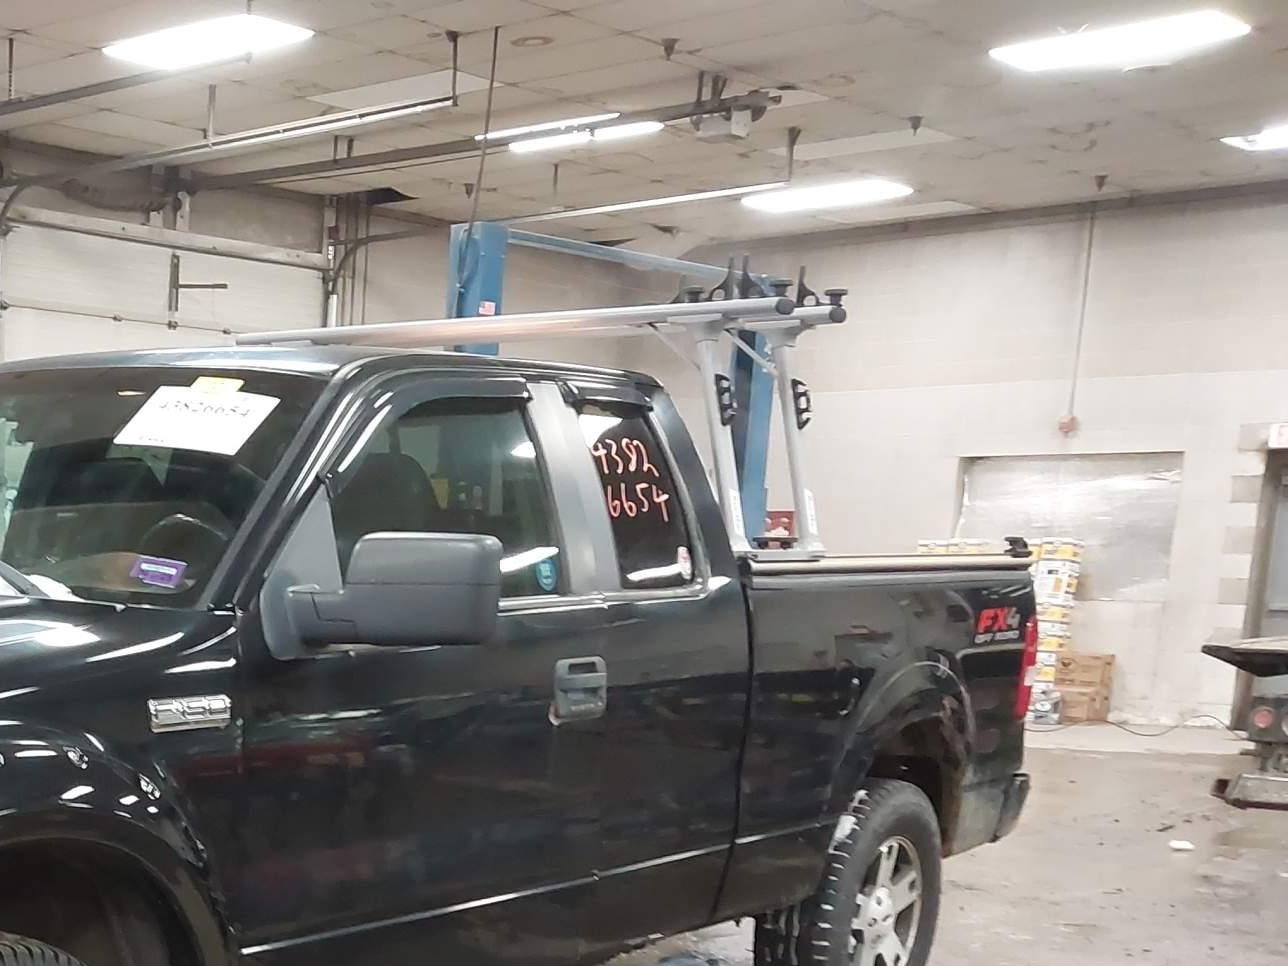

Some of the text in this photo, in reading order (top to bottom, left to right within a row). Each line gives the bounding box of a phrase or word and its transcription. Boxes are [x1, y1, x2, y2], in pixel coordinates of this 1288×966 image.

[591, 438, 659, 477] 4382
[607, 483, 670, 522] 6654
[977, 607, 1020, 633] FX4
